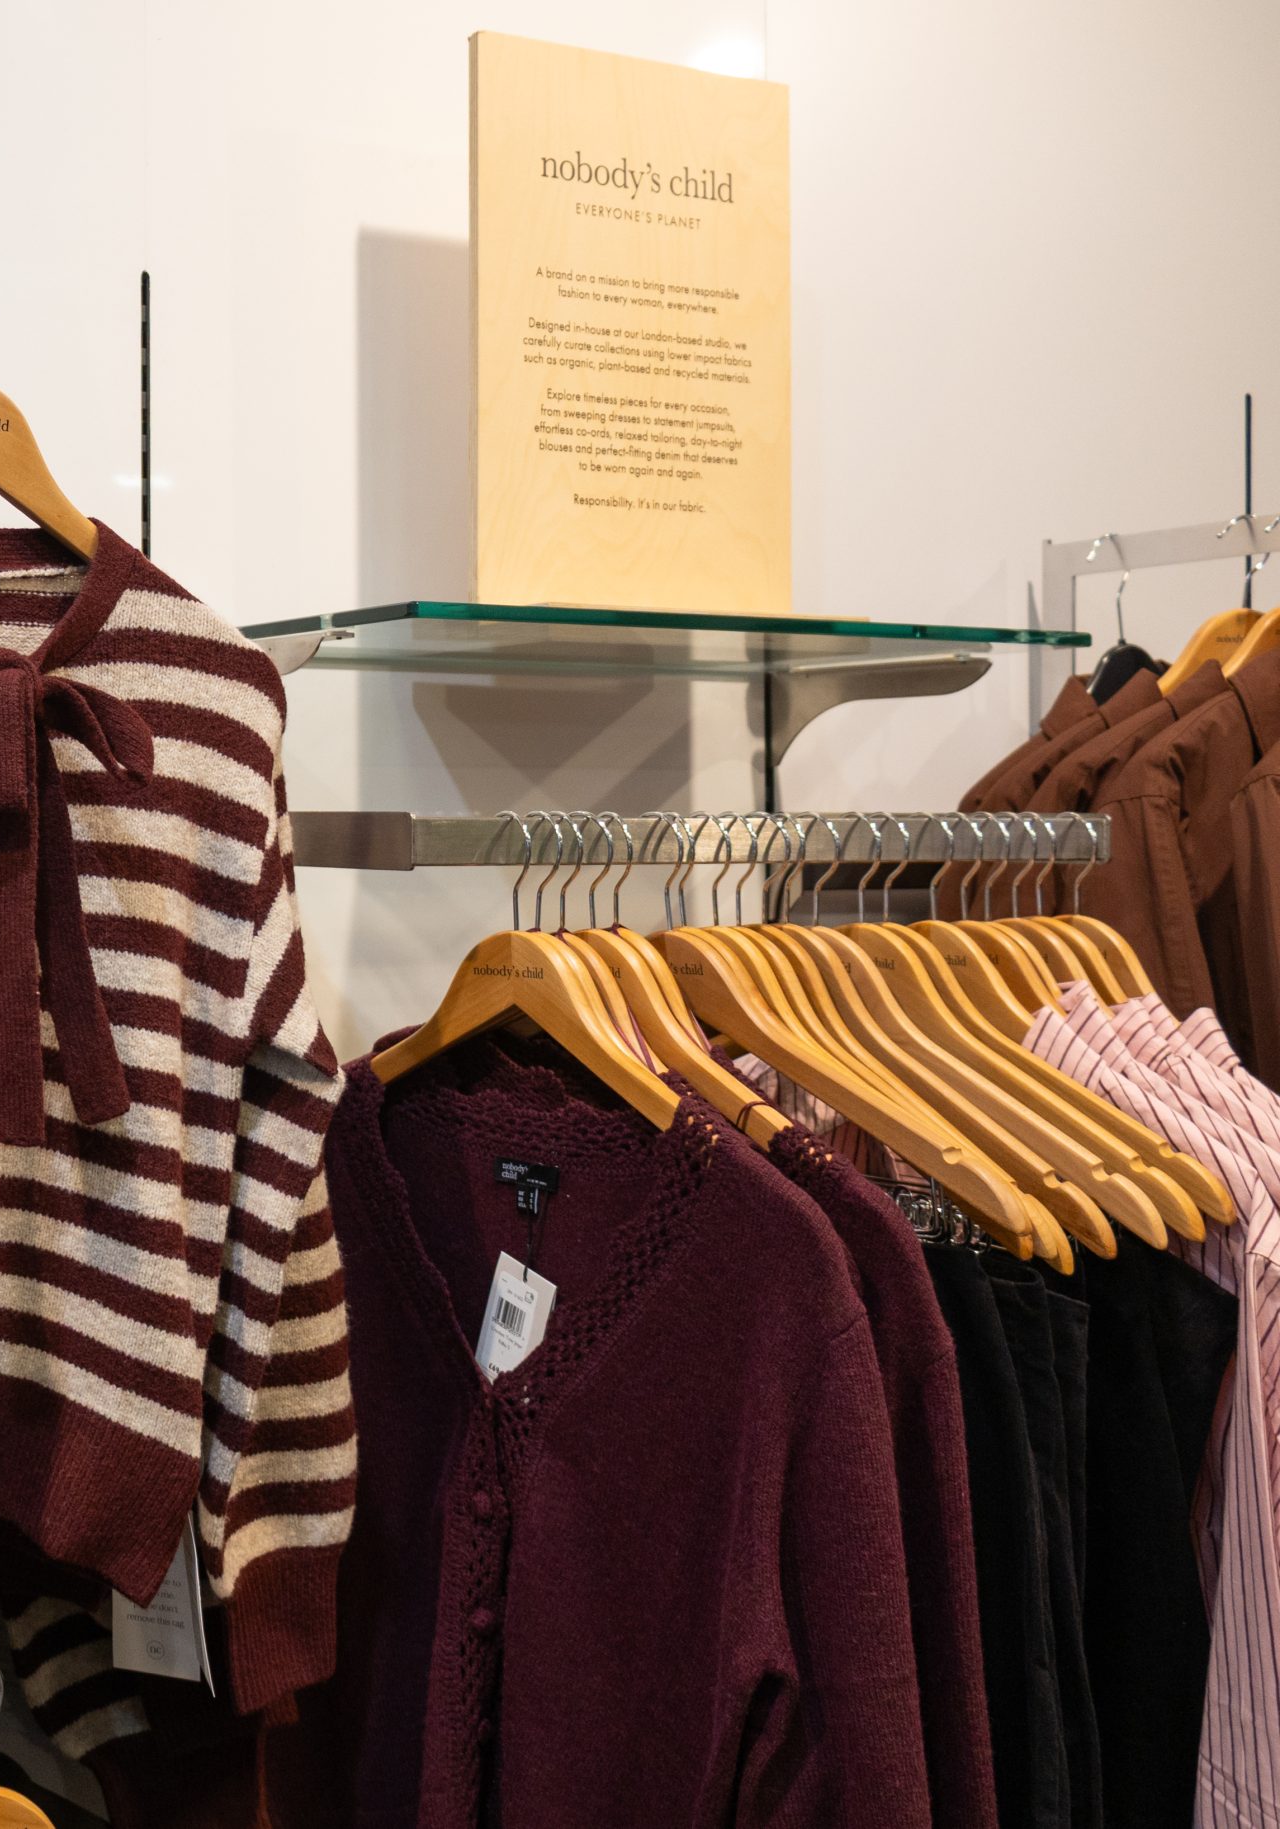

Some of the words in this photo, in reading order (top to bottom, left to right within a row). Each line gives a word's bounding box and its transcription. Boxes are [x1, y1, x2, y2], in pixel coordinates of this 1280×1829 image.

[541, 151, 660, 199] nobody's
[670, 166, 734, 203] child
[576, 202, 651, 223] EVERYONE'S
[657, 213, 700, 229] PLANET
[535, 266, 543, 277] A
[546, 267, 572, 280] brand
[575, 274, 586, 282] on
[589, 275, 595, 283] a
[598, 275, 629, 286] mission
[631, 279, 640, 288] to
[642, 278, 665, 294] bring
[667, 285, 689, 294] more
[691, 287, 739, 300] responsible
[558, 285, 590, 299] fashion
[592, 292, 601, 301] to
[603, 294, 627, 306] every
[528, 316, 570, 333] Designed
[573, 322, 610, 336] in-house
[613, 328, 622, 337] at
[624, 330, 639, 339] our
[641, 329, 702, 345] London-based
[522, 335, 561, 350] carefully
[564, 341, 591, 351] curate
[594, 342, 640, 356] collections
[642, 350, 664, 361] using
[667, 349, 691, 361] lower
[694, 355, 721, 364] impact
[724, 353, 752, 367] fabrics
[523, 352, 543, 363] such
[546, 357, 556, 365] as
[598, 359, 650, 374] plant-based
[653, 365, 670, 376] and
[672, 369, 708, 380] recycled
[547, 387, 581, 401] Explore
[583, 392, 617, 405] timeless
[620, 396, 647, 408] pieces
[650, 396, 661, 408] for
[664, 402, 688, 413] every
[540, 403, 560, 416] from
[563, 410, 606, 424] sweeping
[608, 411, 640, 424] dresses
[642, 416, 651, 424] to
[654, 417, 693, 428] statement
[534, 421, 573, 435] effortless
[615, 430, 648, 441] relaxed
[691, 435, 742, 451] day-to-night
[539, 439, 572, 452] blouses
[575, 443, 592, 454] and
[595, 444, 652, 461] perfect-fitting
[655, 449, 680, 460] denim
[683, 451, 699, 462] that
[701, 454, 737, 465] deserves
[578, 462, 587, 471] to
[590, 460, 601, 472] be
[604, 465, 626, 473] worn
[629, 466, 653, 477] again
[656, 467, 673, 477] and
[638, 498, 650, 509] It's
[652, 499, 659, 509] in
[662, 502, 676, 511] our
[473, 965, 520, 980] nobody's
[521, 967, 544, 980] child
[681, 963, 704, 976] child
